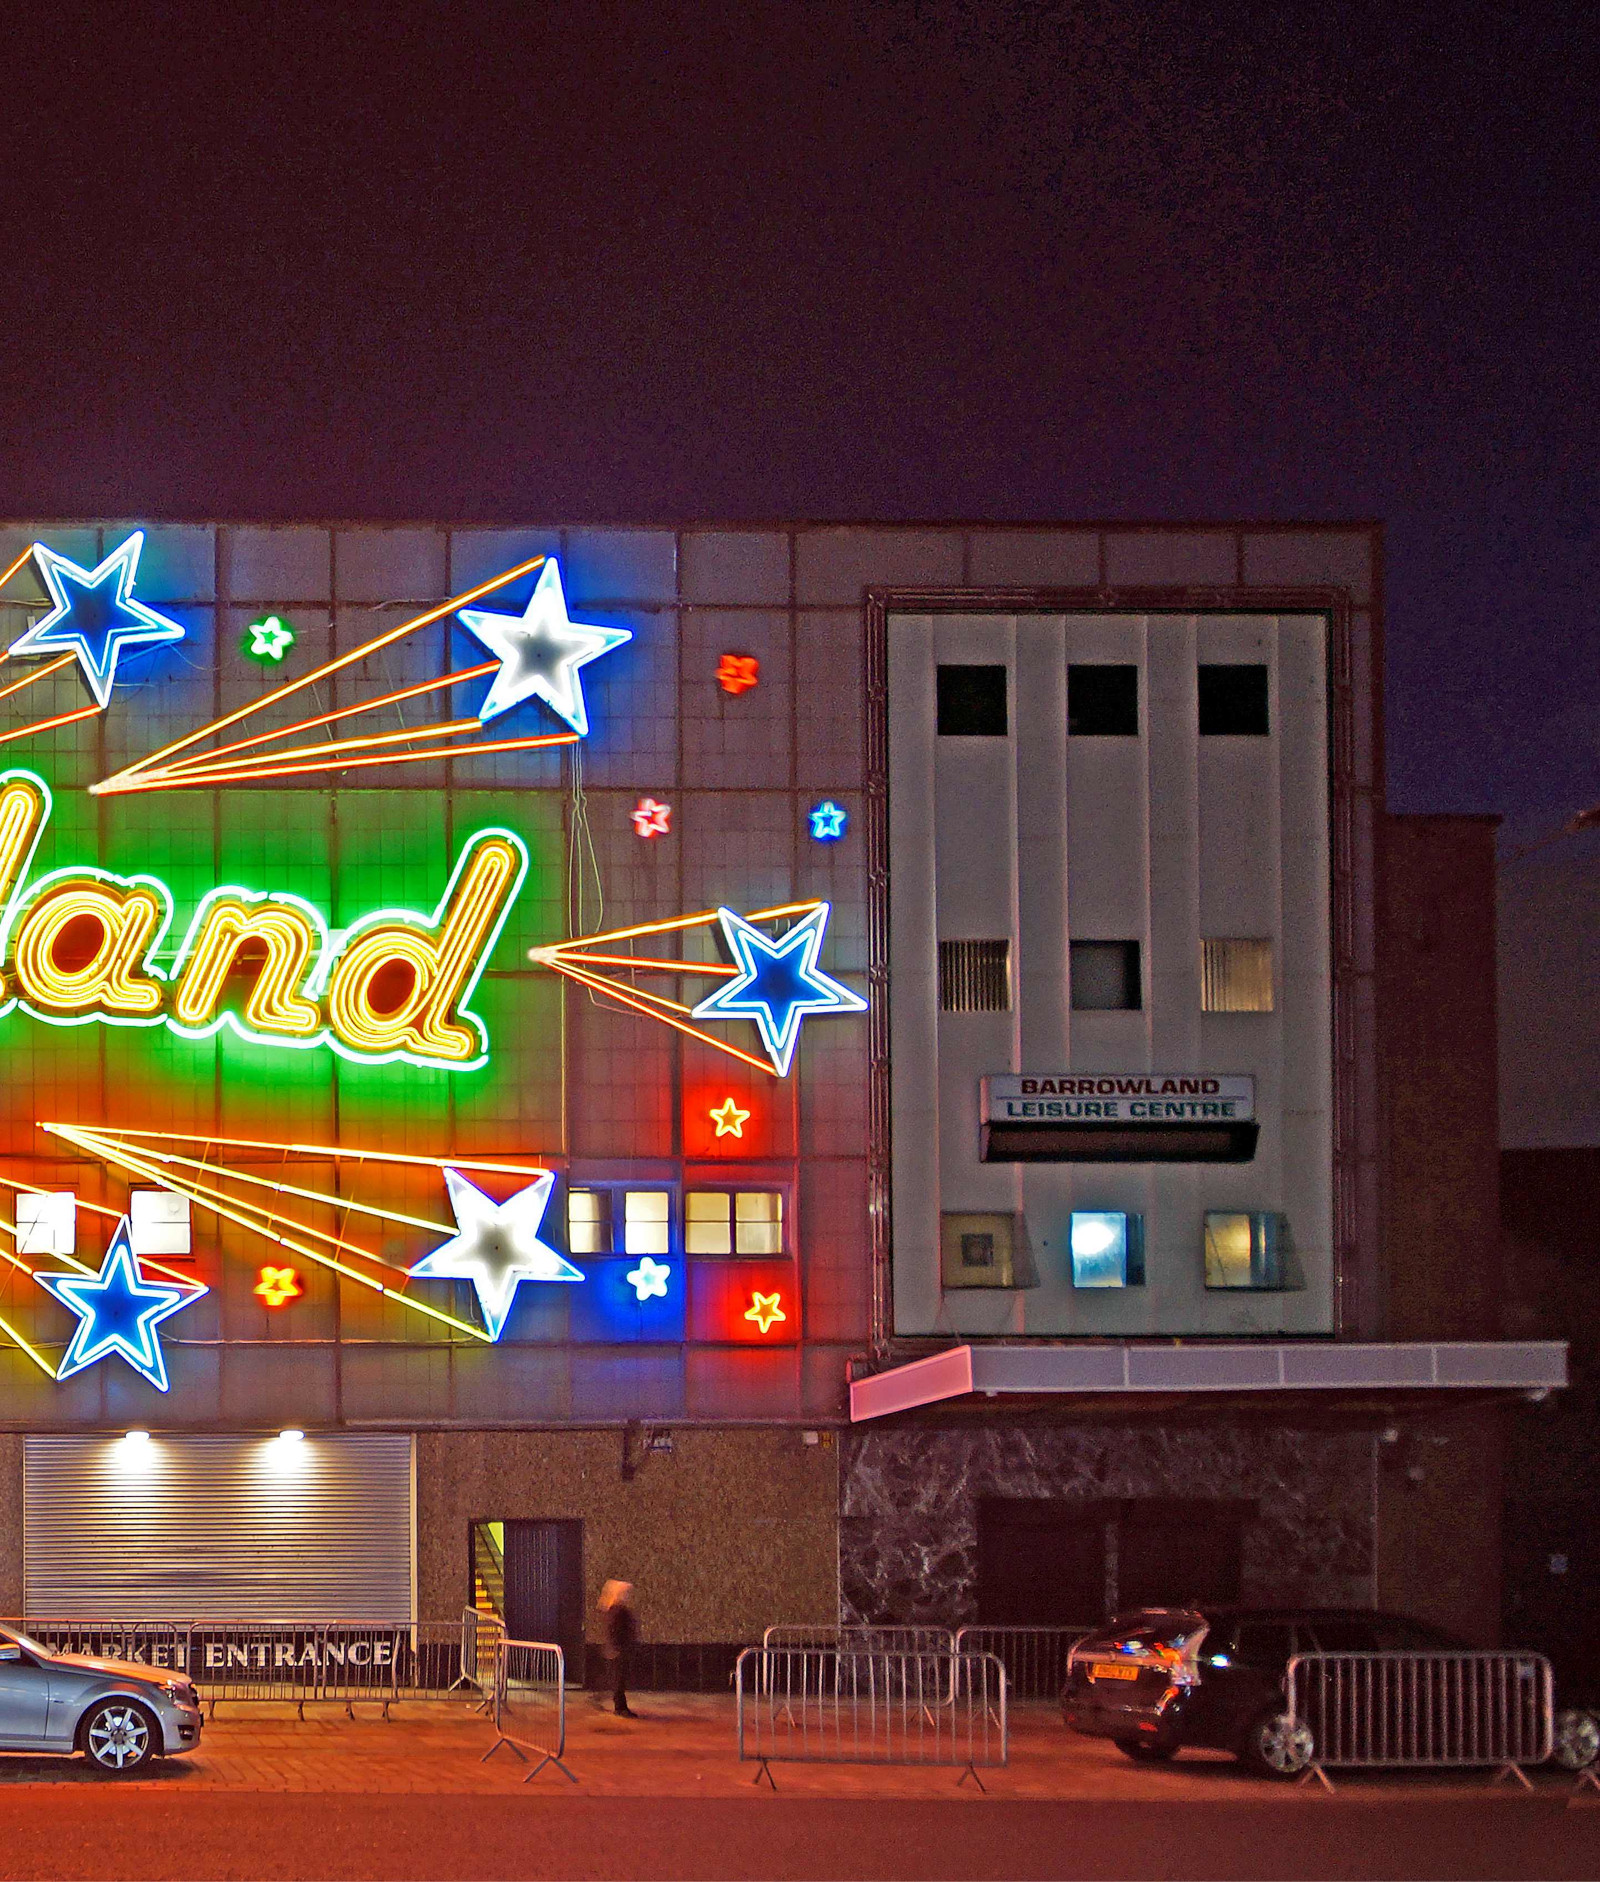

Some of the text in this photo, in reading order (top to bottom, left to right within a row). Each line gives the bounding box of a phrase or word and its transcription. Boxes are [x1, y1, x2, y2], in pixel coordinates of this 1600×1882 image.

[1020, 1078, 1221, 1096] BARROWLAND
[1006, 1101, 1237, 1118] LEISURE CENTRE
[204, 1642, 393, 1668] ENTRANCE
